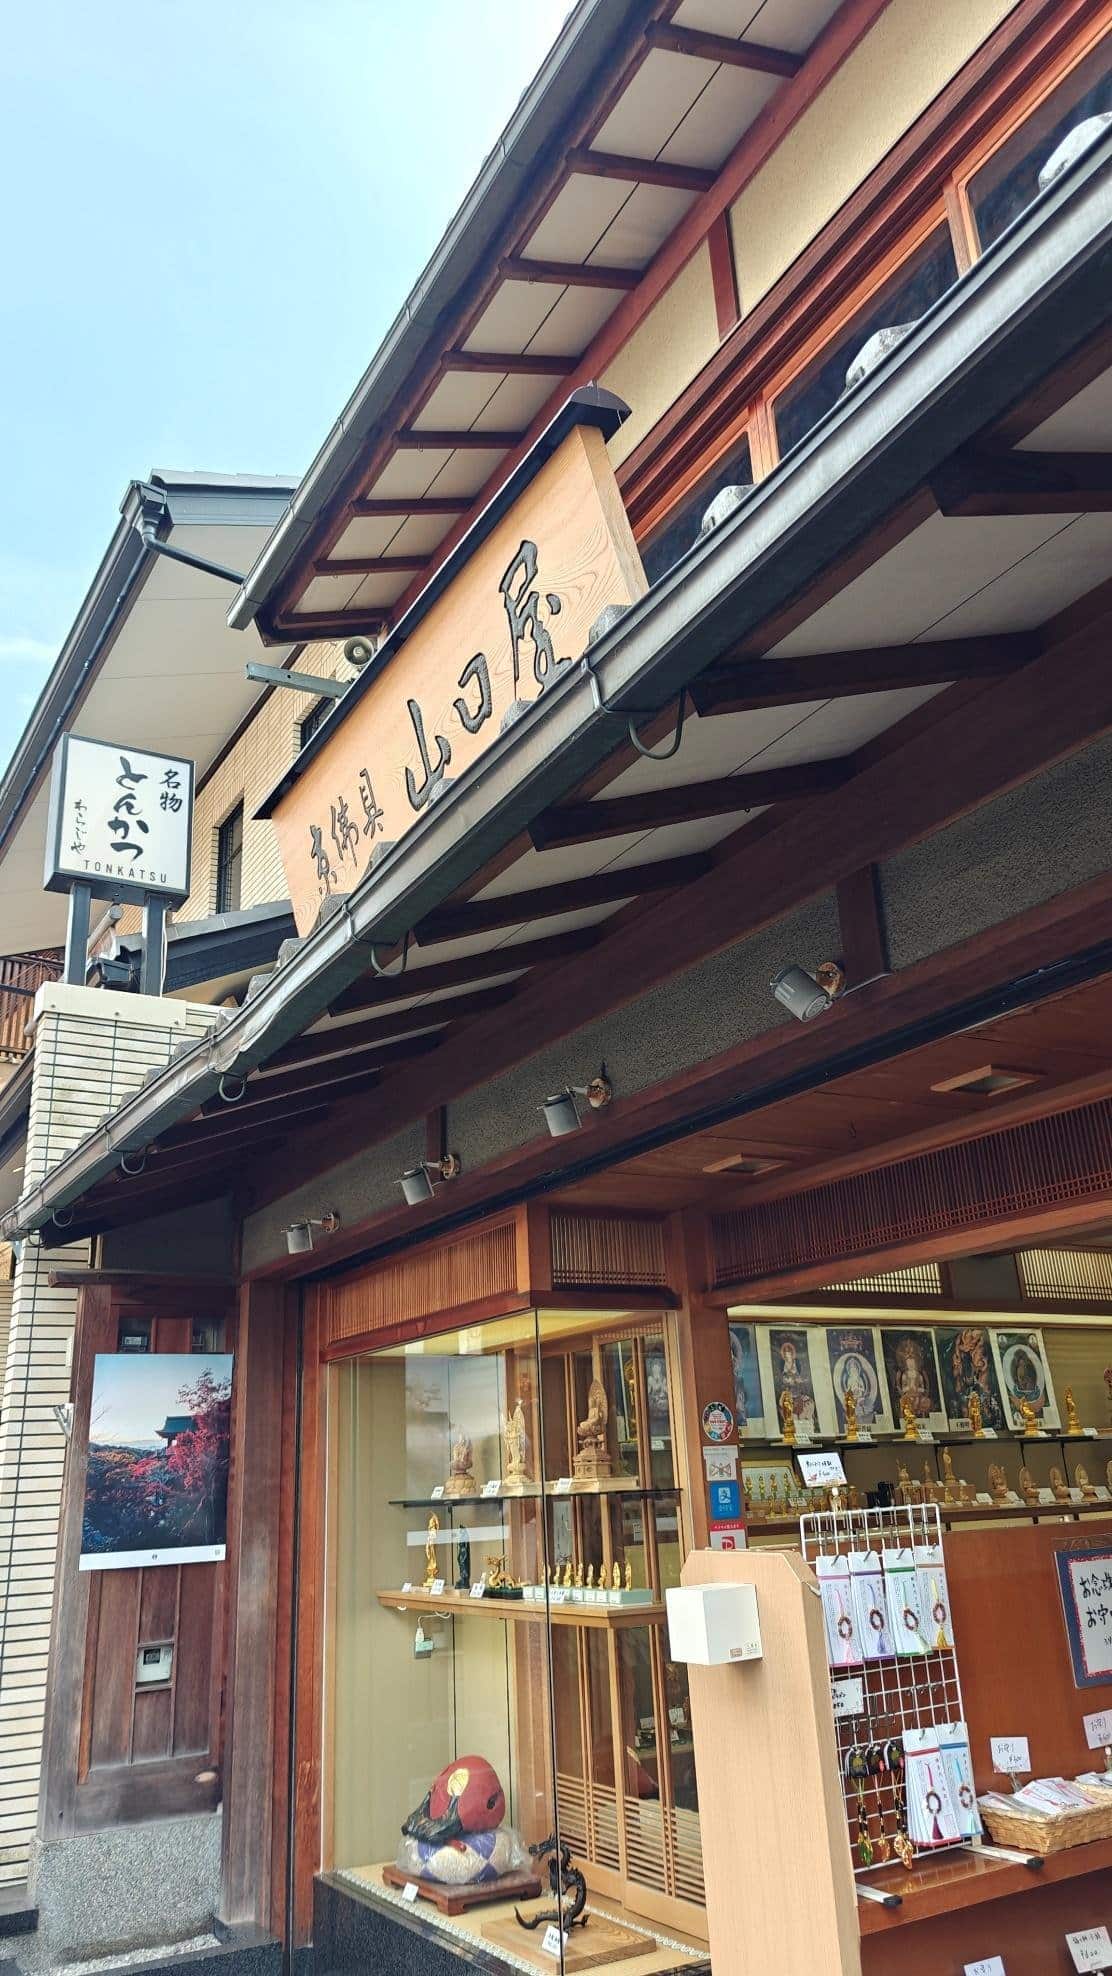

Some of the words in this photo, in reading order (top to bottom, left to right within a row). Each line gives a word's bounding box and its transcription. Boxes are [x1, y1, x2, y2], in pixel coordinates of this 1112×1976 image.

[404, 539, 573, 812] 山口屋
[107, 755, 150, 862] とんかつ
[159, 768, 183, 813] 名物
[83, 859, 168, 883] TONKATSU
[1086, 1603, 1112, 1629] お守
